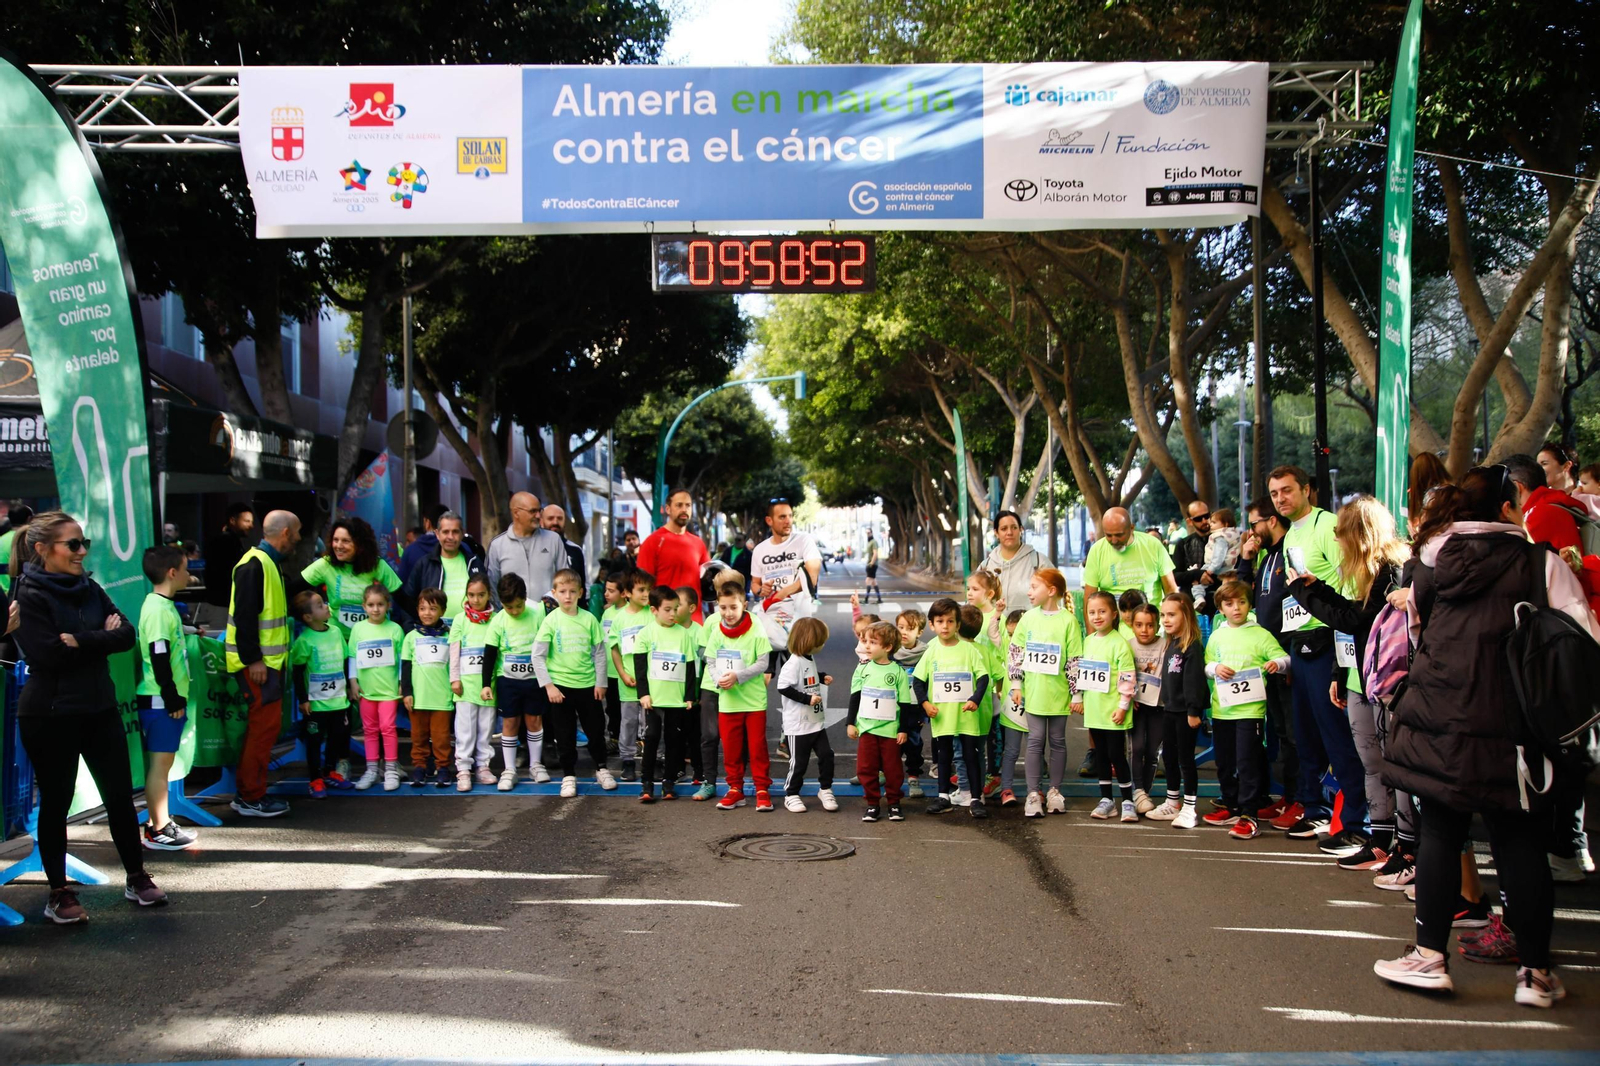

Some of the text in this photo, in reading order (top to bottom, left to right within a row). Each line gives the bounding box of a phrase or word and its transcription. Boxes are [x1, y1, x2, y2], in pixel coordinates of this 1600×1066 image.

[1036, 86, 1117, 106] cajamar
[1180, 88, 1251, 97] UNIVERSIDAD
[552, 82, 956, 117] Almería en marcha
[1181, 96, 1251, 107] DE ALMERÍA
[553, 128, 902, 164] contra el cáncer
[1115, 135, 1210, 154] Fundación
[463, 156, 502, 165] DE CABRAS
[255, 167, 319, 182] ALMERÍA
[1164, 166, 1243, 182] Ejido Motor
[271, 183, 305, 192] CIUDAD
[884, 182, 972, 193] asociación española
[1044, 179, 1084, 190] Toyota
[885, 192, 954, 201] contra el cáncer
[1043, 193, 1127, 202] Alborán Motor
[1210, 190, 1225, 202] FIAT
[541, 198, 680, 209] #TodosContraElCáncer
[885, 202, 935, 211] en Almería
[688, 240, 866, 286] 09:58:52
[762, 552, 796, 564] Cooke
[367, 648, 383, 658] 99
[430, 644, 438, 654] 3
[1028, 652, 1057, 664] 1129
[511, 663, 534, 673] 886
[662, 661, 677, 672] 87
[1077, 669, 1106, 683] 1116
[321, 681, 336, 692] 24
[944, 682, 961, 692] 95
[1230, 681, 1251, 694] 32
[872, 699, 879, 710] 1
